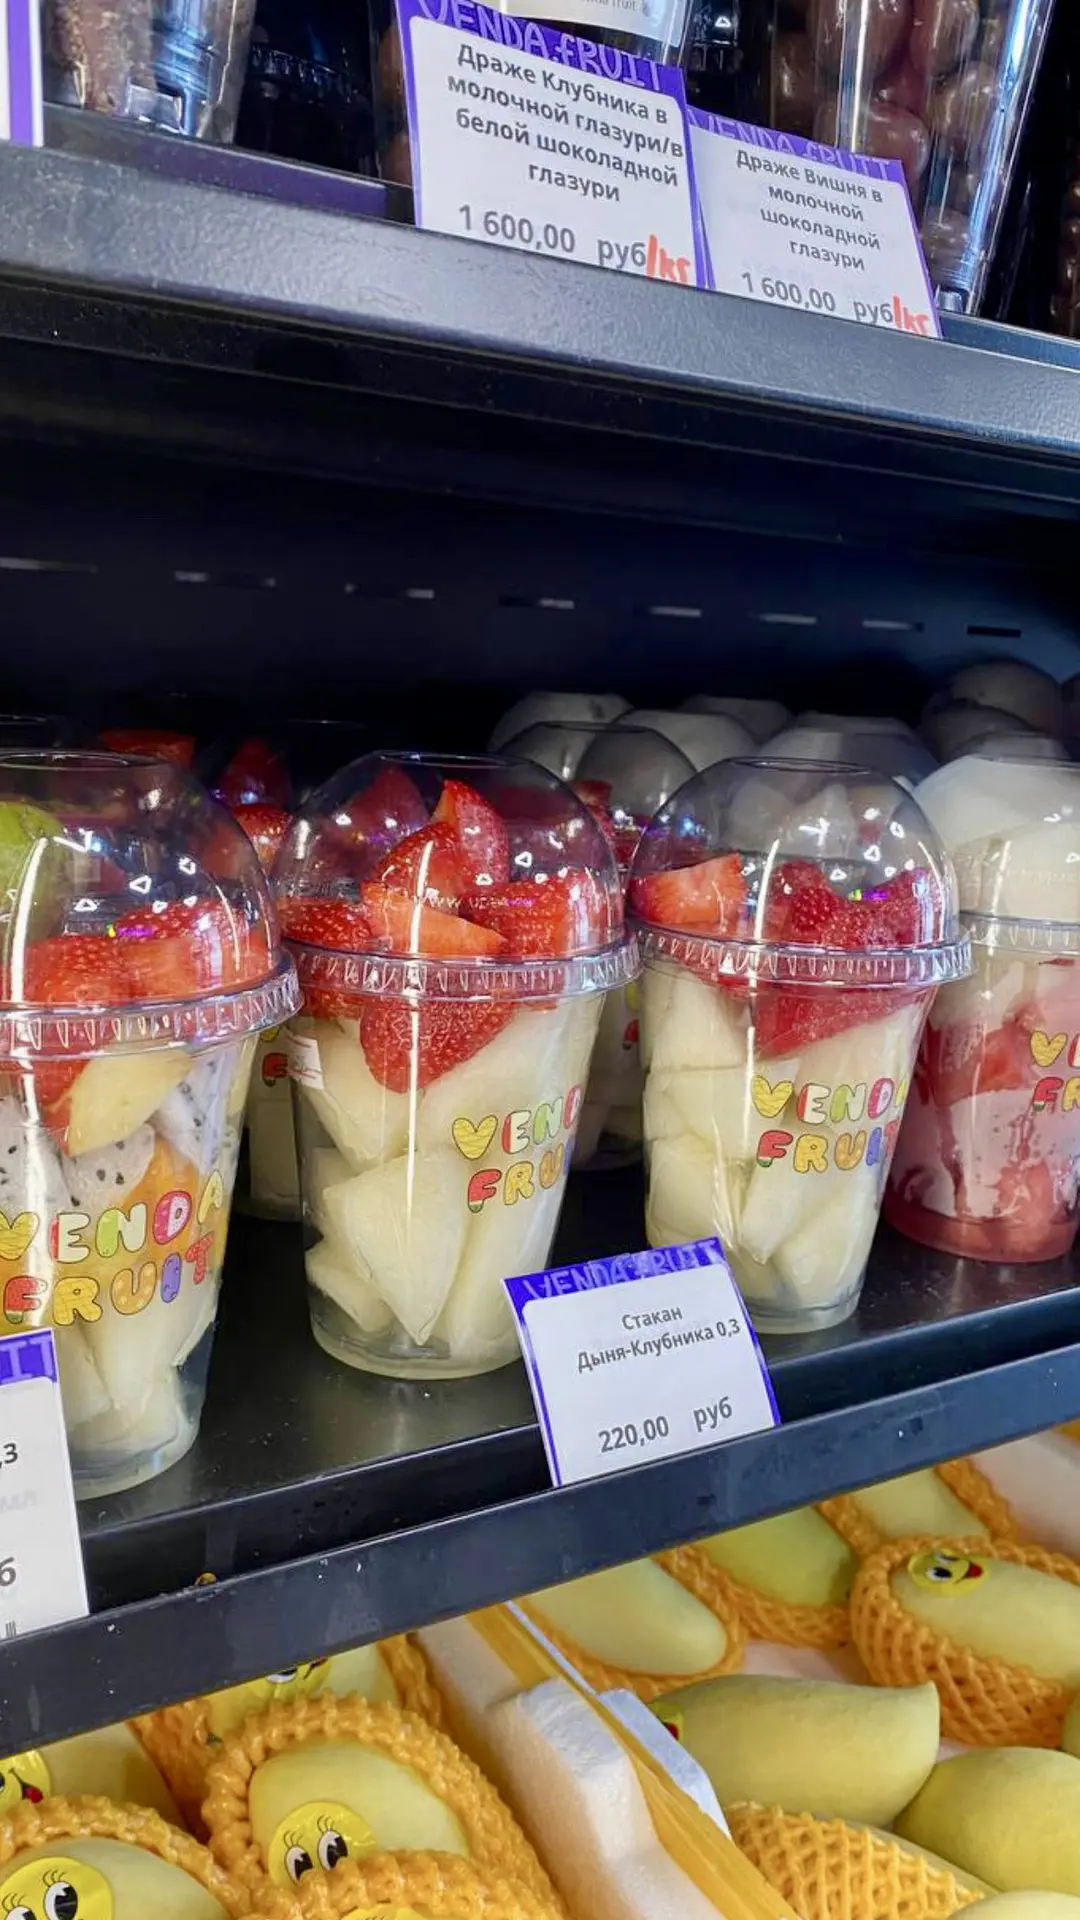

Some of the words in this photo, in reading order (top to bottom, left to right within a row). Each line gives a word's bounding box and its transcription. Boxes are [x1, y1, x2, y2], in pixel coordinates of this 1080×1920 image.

[458, 44, 537, 84] Драже
[542, 70, 650, 120] Клубника
[656, 109, 668, 124] в
[447, 75, 569, 125] молочной
[575, 113, 685, 158] глазури/в
[456, 108, 531, 146] белой
[536, 135, 679, 187] шоколадной
[528, 163, 620, 201] глазури
[736, 150, 800, 181] Драже
[805, 167, 867, 199] Вишня
[872, 190, 883, 203] в
[769, 186, 864, 222] молочной
[483, 211, 576, 252] 600,00
[597, 238, 645, 269] руб
[760, 208, 881, 250] шоколадной
[790, 241, 865, 271] глазури
[761, 277, 836, 312] 600,00
[853, 300, 893, 325] руб
[0, 1170, 224, 1264] VENDA
[3, 1231, 215, 1326] FRUIT
[621, 1306, 683, 1331] Стакан
[577, 1325, 714, 1374] Дыня-Клубника
[716, 1319, 741, 1339] 0,3
[599, 1415, 670, 1453] 220,00
[693, 1396, 733, 1432] руб
